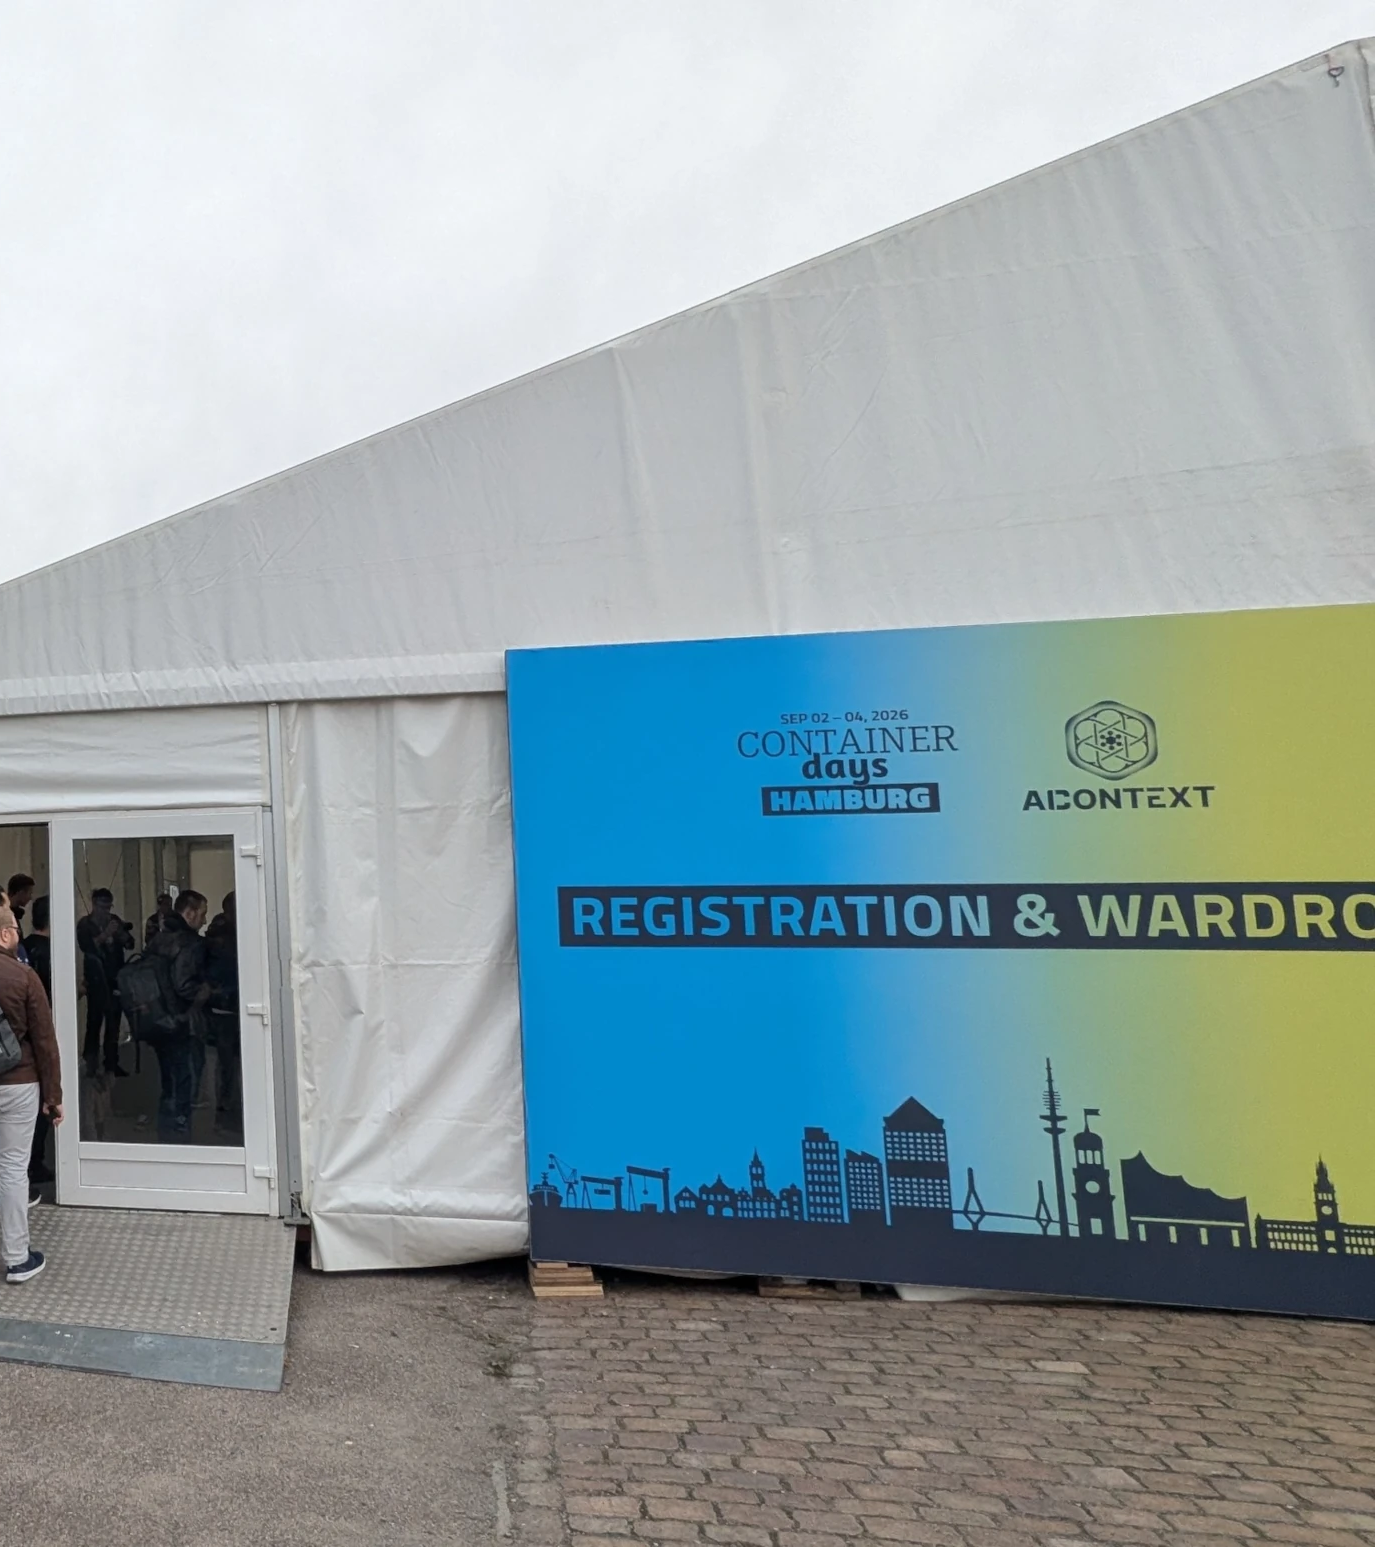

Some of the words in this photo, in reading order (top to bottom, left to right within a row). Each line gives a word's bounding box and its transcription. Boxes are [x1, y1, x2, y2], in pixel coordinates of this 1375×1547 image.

[780, 713, 807, 724] SEP
[812, 712, 829, 723] 02
[845, 712, 867, 723] 04,
[872, 709, 909, 721] 2026
[737, 725, 959, 758] CONTAINER
[802, 752, 888, 786] days
[771, 787, 930, 812] HAMBURG
[572, 893, 991, 940] REGISTRATION
[1013, 893, 1061, 939] &
[1078, 892, 1375, 940] WARDRO
